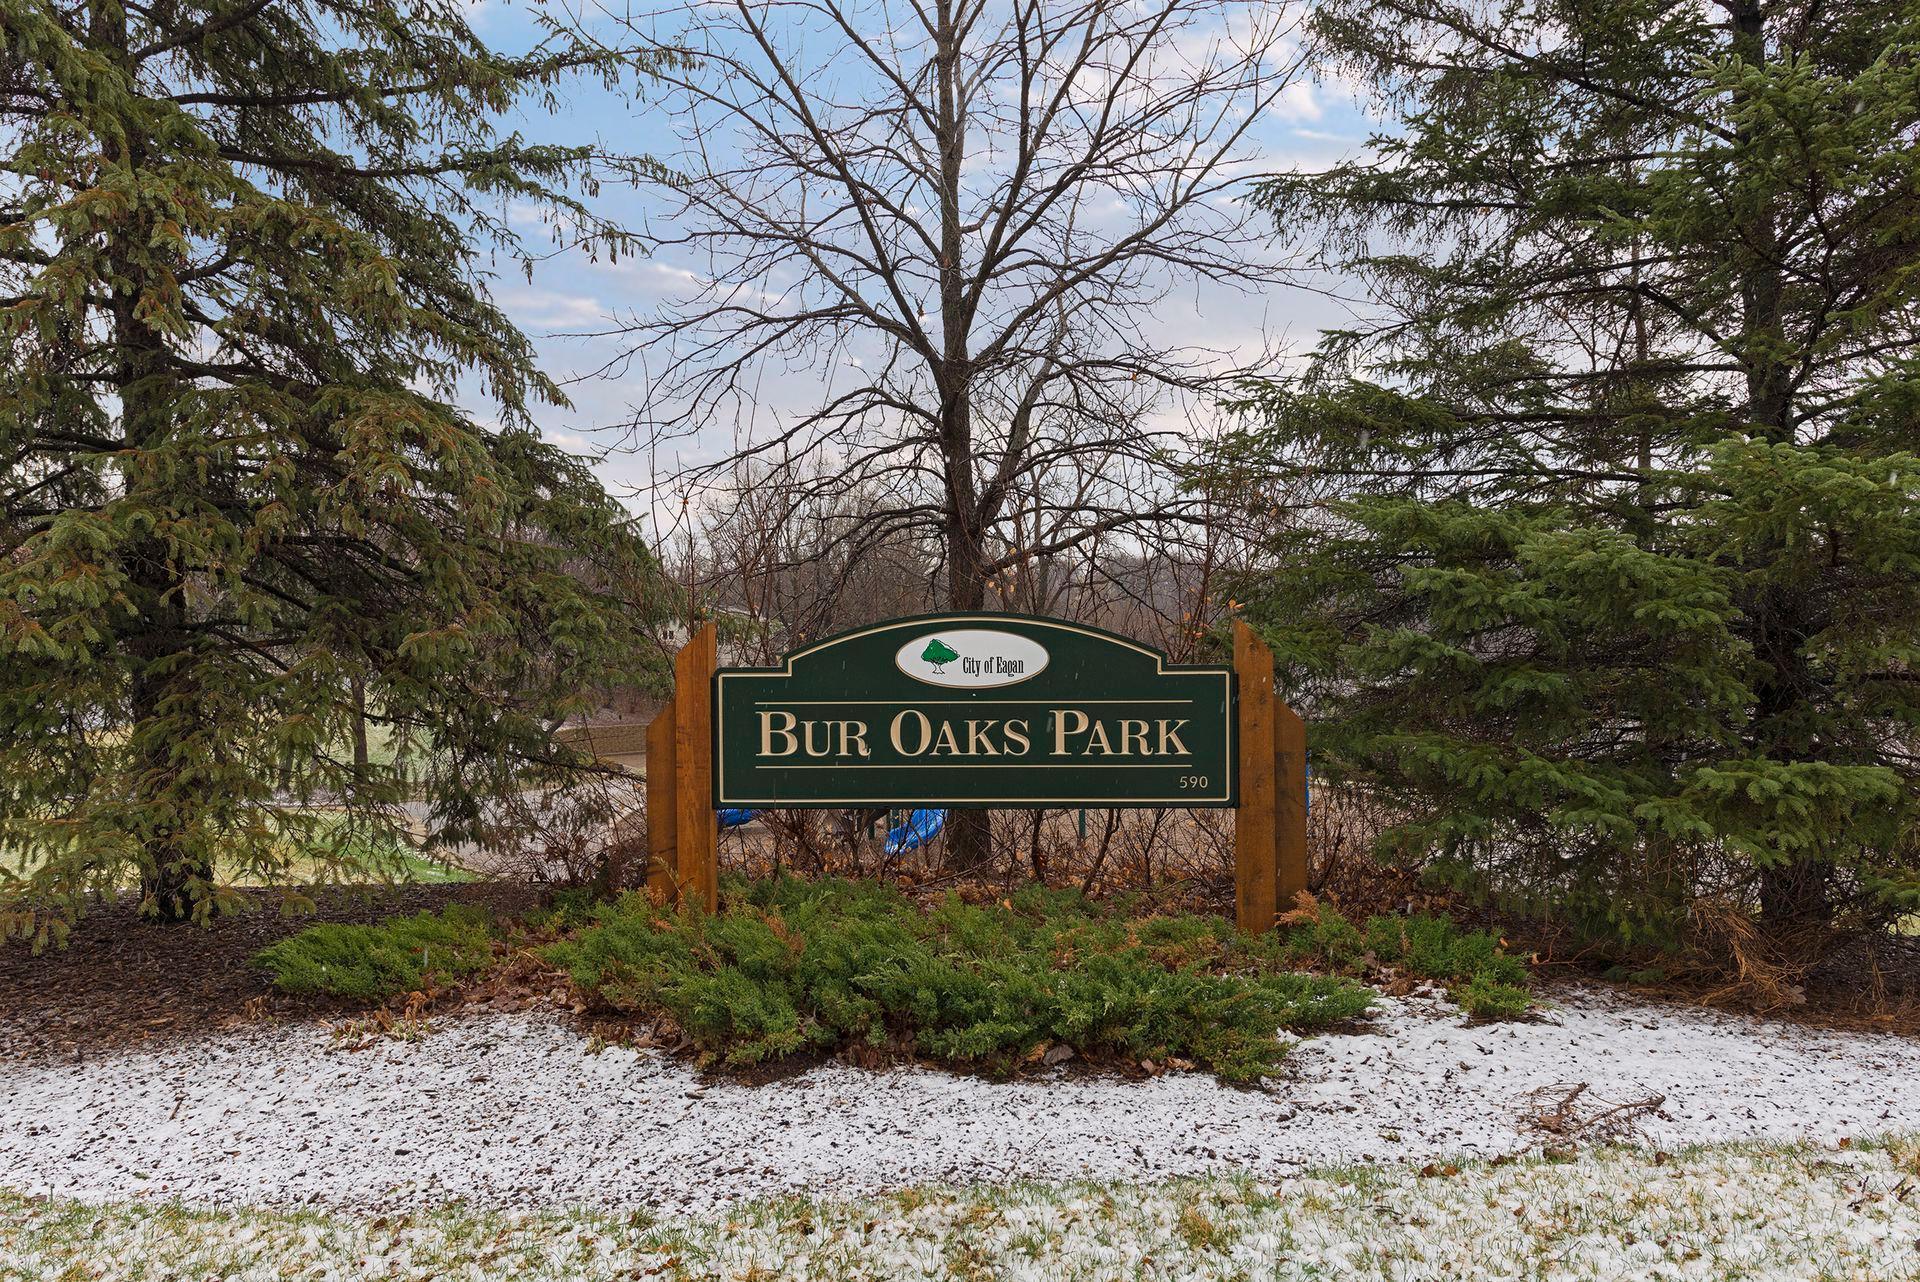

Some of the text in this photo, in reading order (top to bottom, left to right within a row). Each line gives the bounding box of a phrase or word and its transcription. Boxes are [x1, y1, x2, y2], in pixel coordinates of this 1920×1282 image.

[962, 656, 1024, 677] City of Eagan
[756, 710, 1192, 756] BUR OAKS PARK
[1179, 775, 1208, 789] 590
